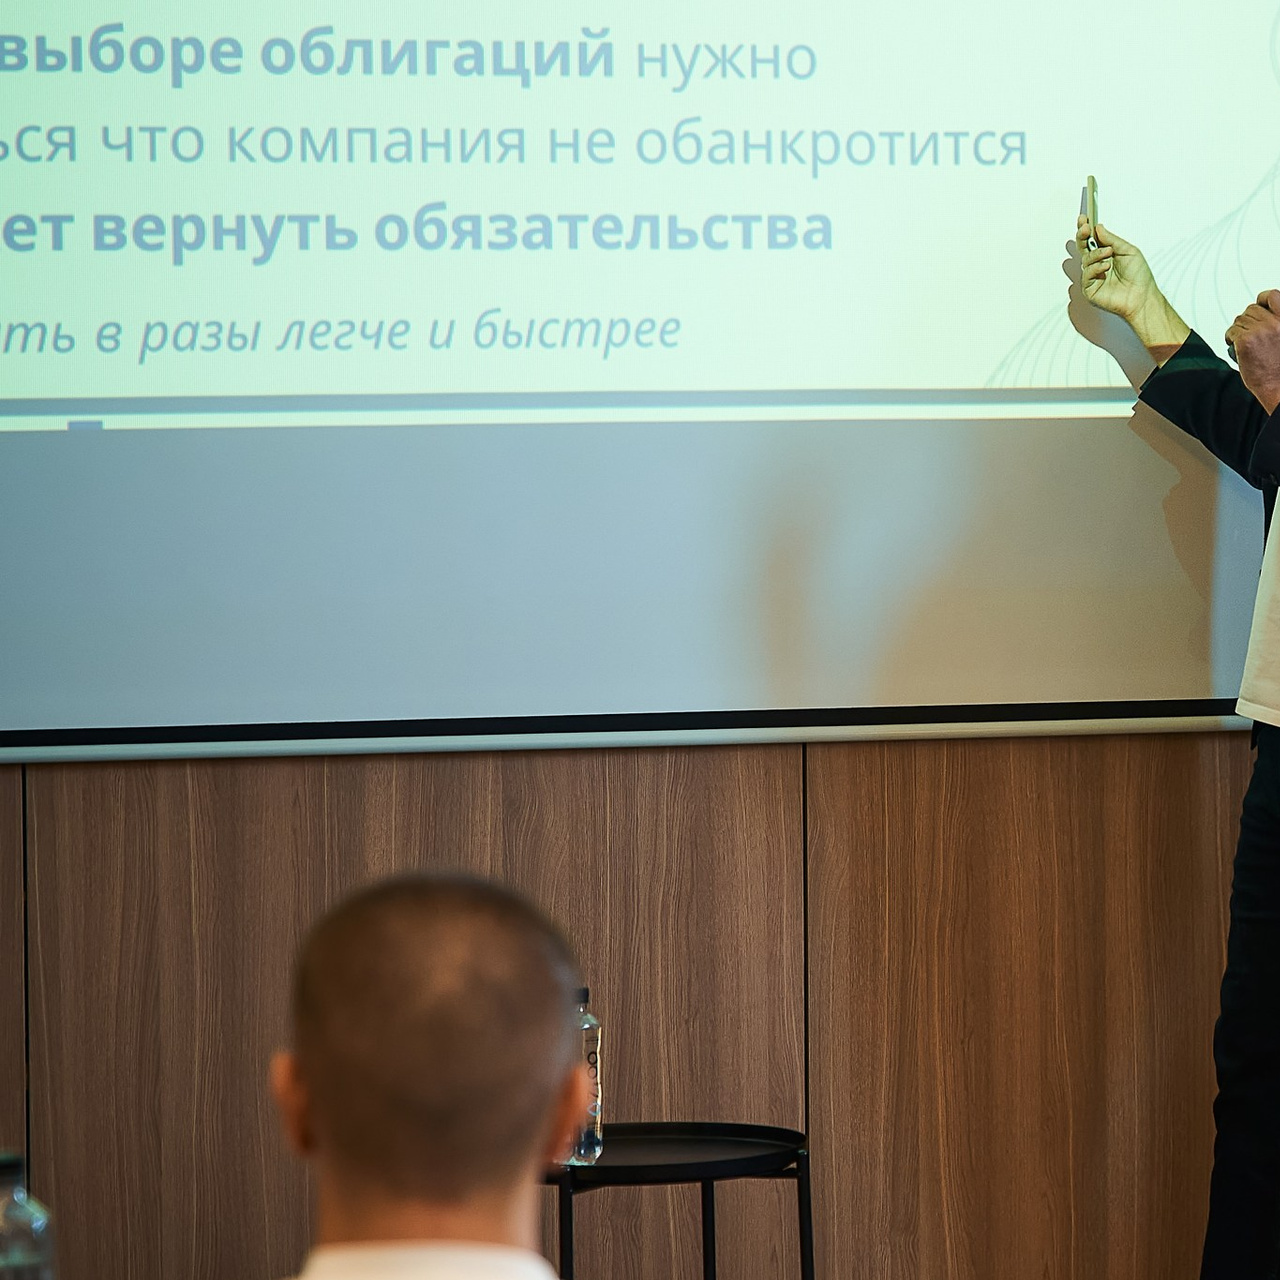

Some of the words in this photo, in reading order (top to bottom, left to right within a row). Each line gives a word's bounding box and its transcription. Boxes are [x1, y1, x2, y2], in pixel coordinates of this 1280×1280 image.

[0, 23, 243, 89] выборе
[261, 26, 615, 89] облигаций
[637, 41, 817, 93] нужно
[101, 125, 205, 163] что
[228, 126, 526, 163] компания
[549, 126, 616, 164] не
[636, 116, 1027, 179] обанкротится
[2, 214, 75, 252] ет
[93, 213, 358, 266] вернуть
[375, 201, 833, 252] обязательства
[96, 321, 122, 354] в
[138, 319, 261, 365] разы
[275, 317, 411, 352] легче
[428, 318, 456, 350] и
[474, 308, 681, 361] быстрее
